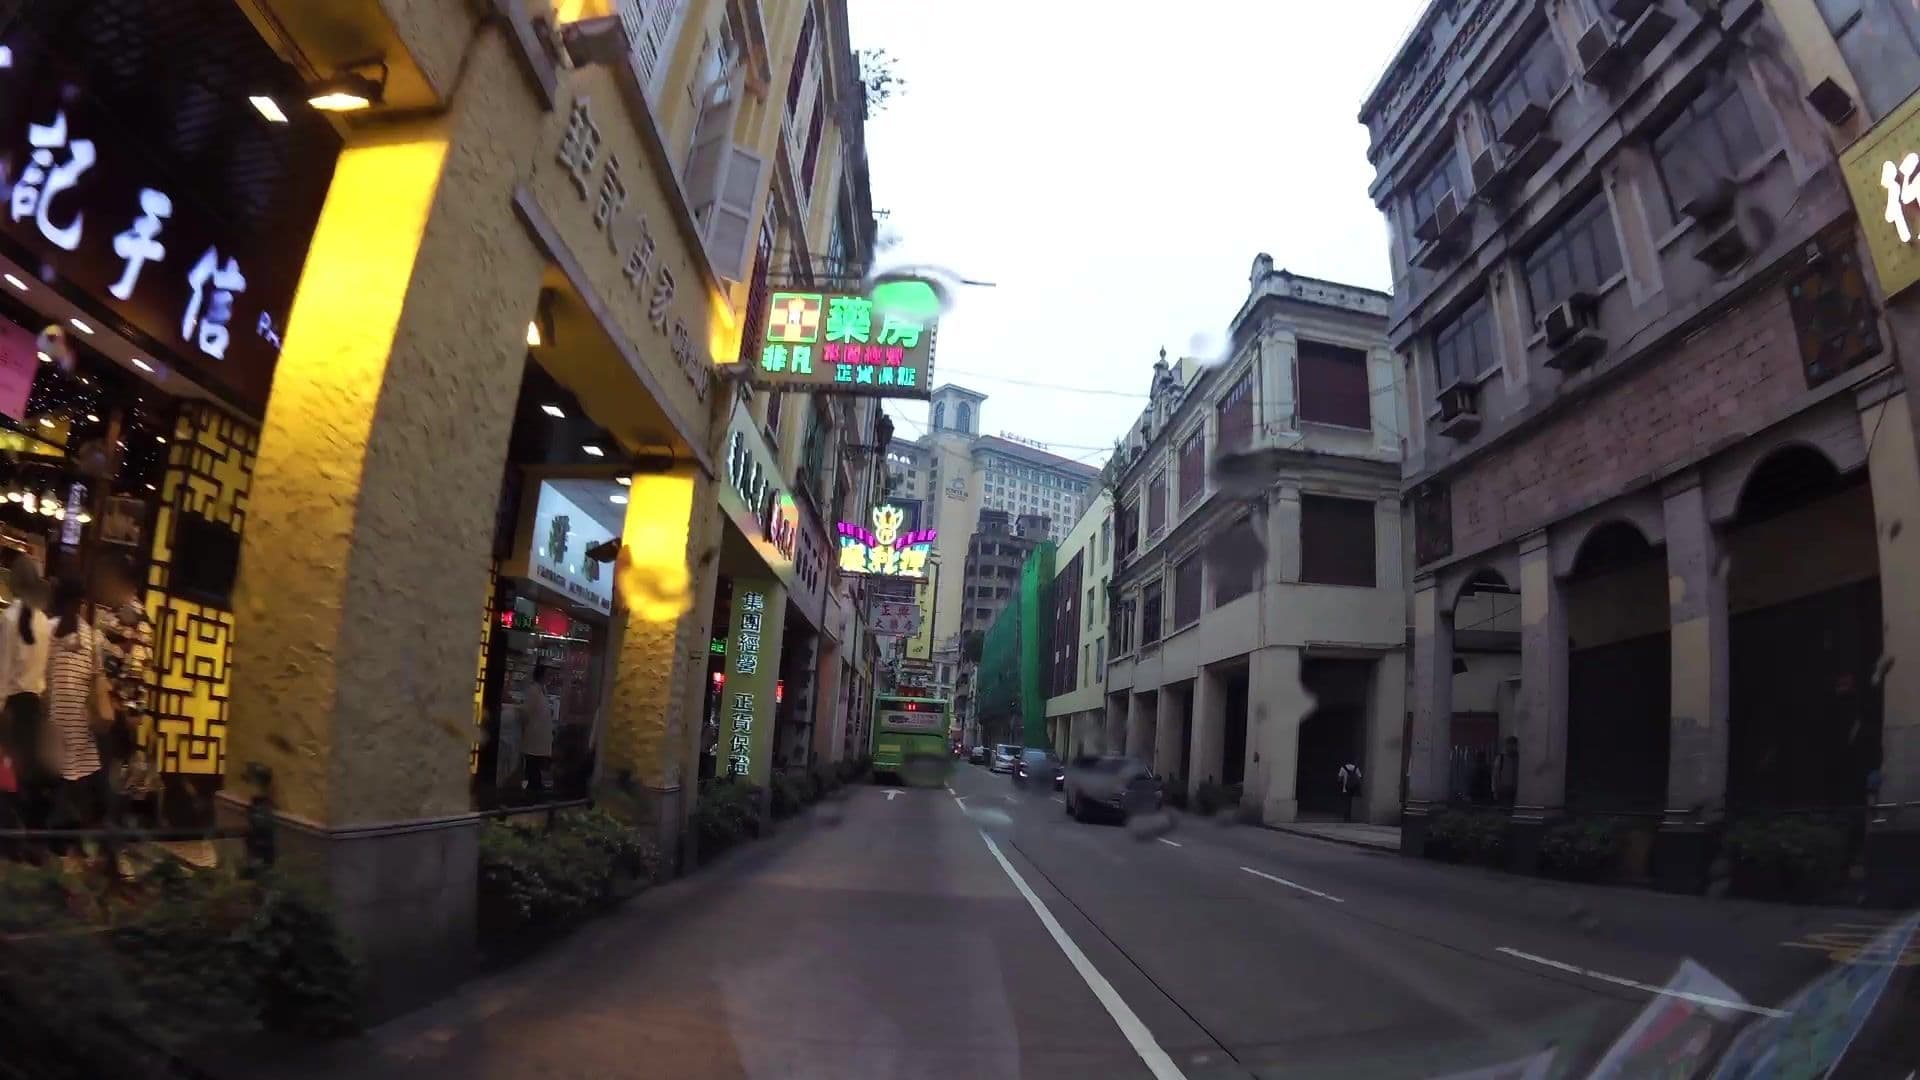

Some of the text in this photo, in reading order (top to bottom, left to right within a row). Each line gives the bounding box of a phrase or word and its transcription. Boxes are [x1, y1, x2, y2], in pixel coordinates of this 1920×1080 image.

[761, 344, 812, 374] 非凡
[727, 591, 764, 777] 集團經營 正貨保證
